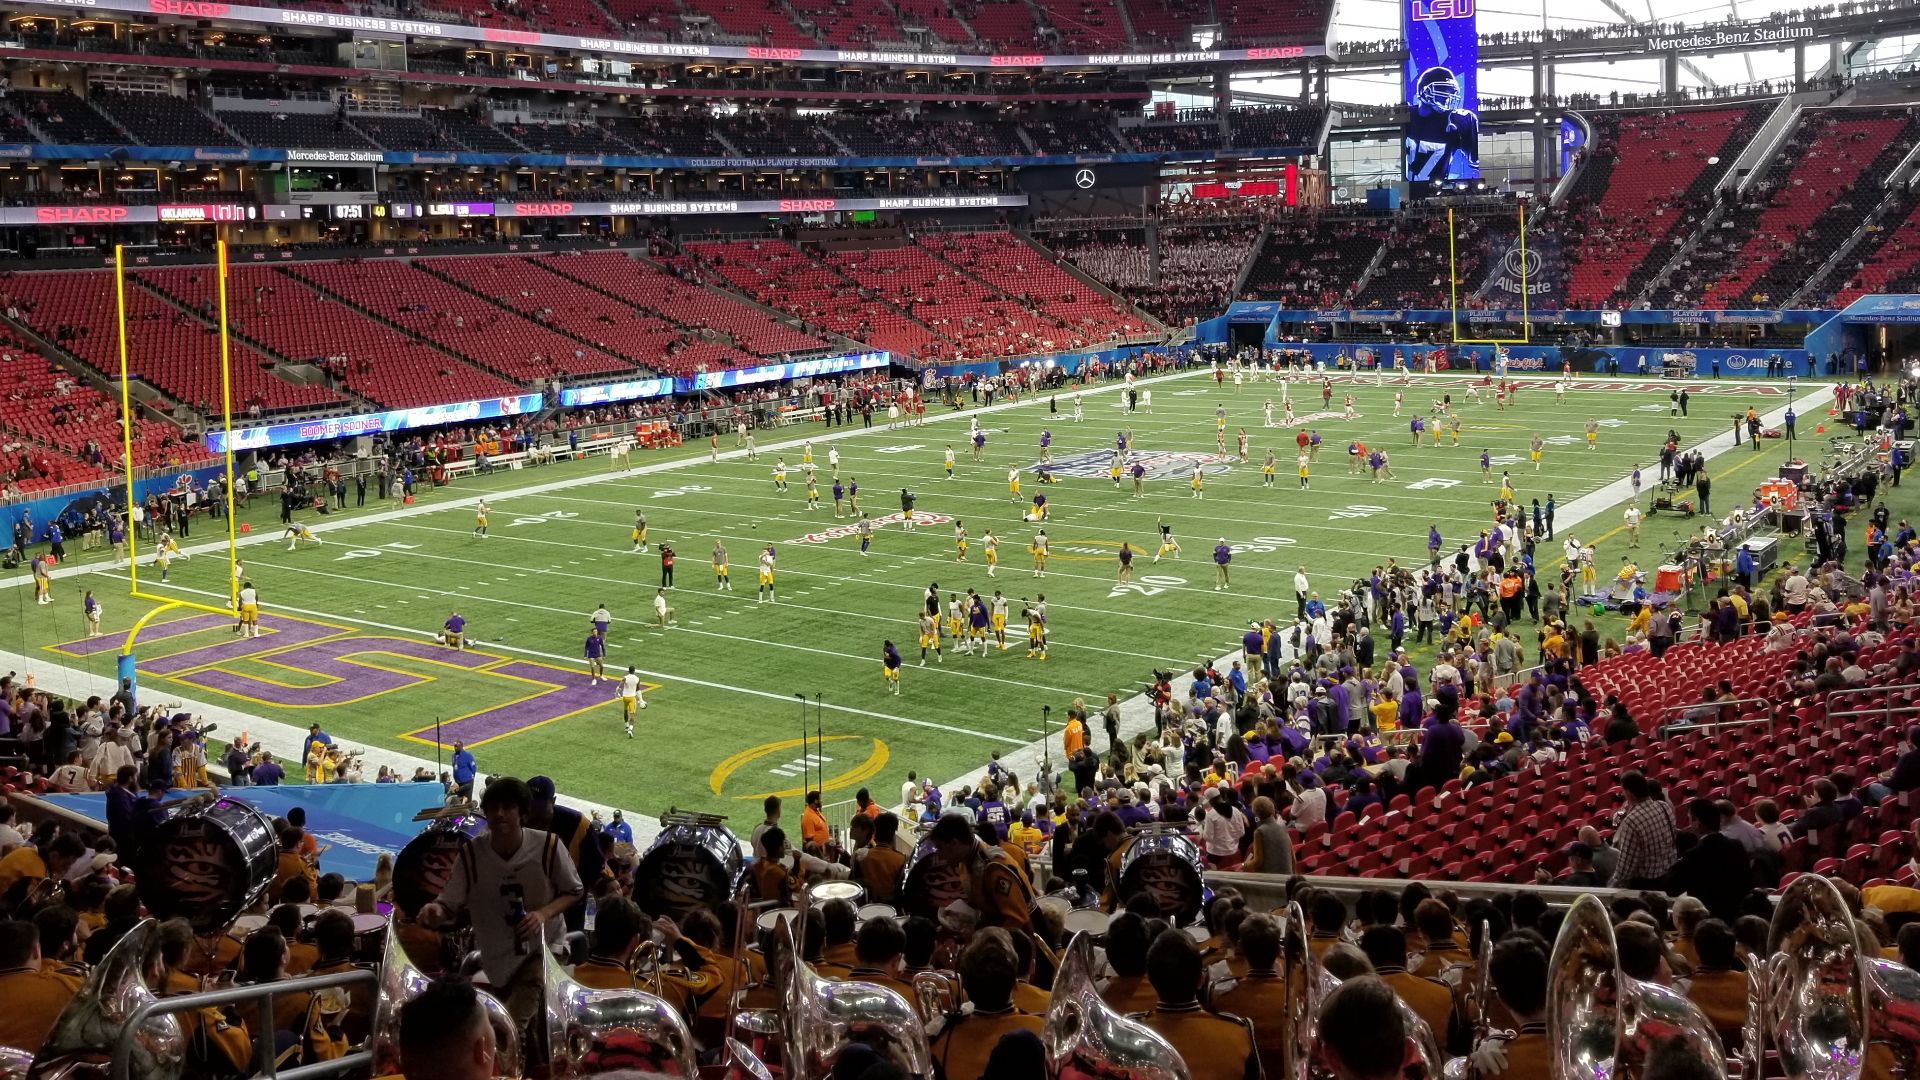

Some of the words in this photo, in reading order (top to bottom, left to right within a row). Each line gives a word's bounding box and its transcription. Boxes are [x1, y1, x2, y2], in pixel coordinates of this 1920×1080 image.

[148, 0, 229, 17] SHARP
[1412, 0, 1475, 21] LSU
[282, 11, 324, 24] SHARP
[328, 15, 386, 30] BUSINESS
[390, 21, 441, 35] SYSTEMS
[1648, 30, 1750, 51] Mercedes-Benz
[1754, 26, 1814, 42] Stadium
[580, 39, 611, 50] SHARP
[613, 42, 659, 54] BUSINESS
[662, 45, 709, 56] SYSTEMS
[748, 47, 801, 59] SHARP
[1247, 46, 1304, 59] SHARP
[838, 51, 869, 61] SHARP
[871, 53, 915, 63] BUSINESS
[917, 54, 956, 64] SYSTEMS
[991, 56, 1043, 66] SHARP
[1088, 55, 1119, 64] SHARP
[1122, 55, 1171, 64] BUSINESS
[1174, 52, 1220, 62] SYSTEMS
[287, 150, 349, 162] Mercedes-Benz
[350, 151, 384, 162] Stadium
[691, 159, 725, 167] COLLEGE
[727, 158, 766, 167] FOOTBALL
[767, 158, 798, 166] PLAYOFF
[800, 157, 838, 166] SEMIFINAL
[515, 203, 573, 215] SHARP
[611, 204, 640, 213] SHARP
[644, 204, 687, 213] BUSINESS
[690, 203, 738, 212] SYSTEMS
[780, 200, 834, 211] SHARP
[880, 200, 909, 208] SHARP
[912, 199, 956, 207] BUSINESS
[959, 197, 998, 206] SYSTEMS
[36, 207, 128, 223] SHARP
[160, 207, 205, 219] OKLAHOMA
[1494, 276, 1551, 295] Allstate
[1602, 312, 1620, 326] 40
[300, 424, 342, 438] BOOMER
[343, 418, 382, 433] SOONER
[1110, 576, 1187, 597] 20
[67, 770, 77, 785] 7
